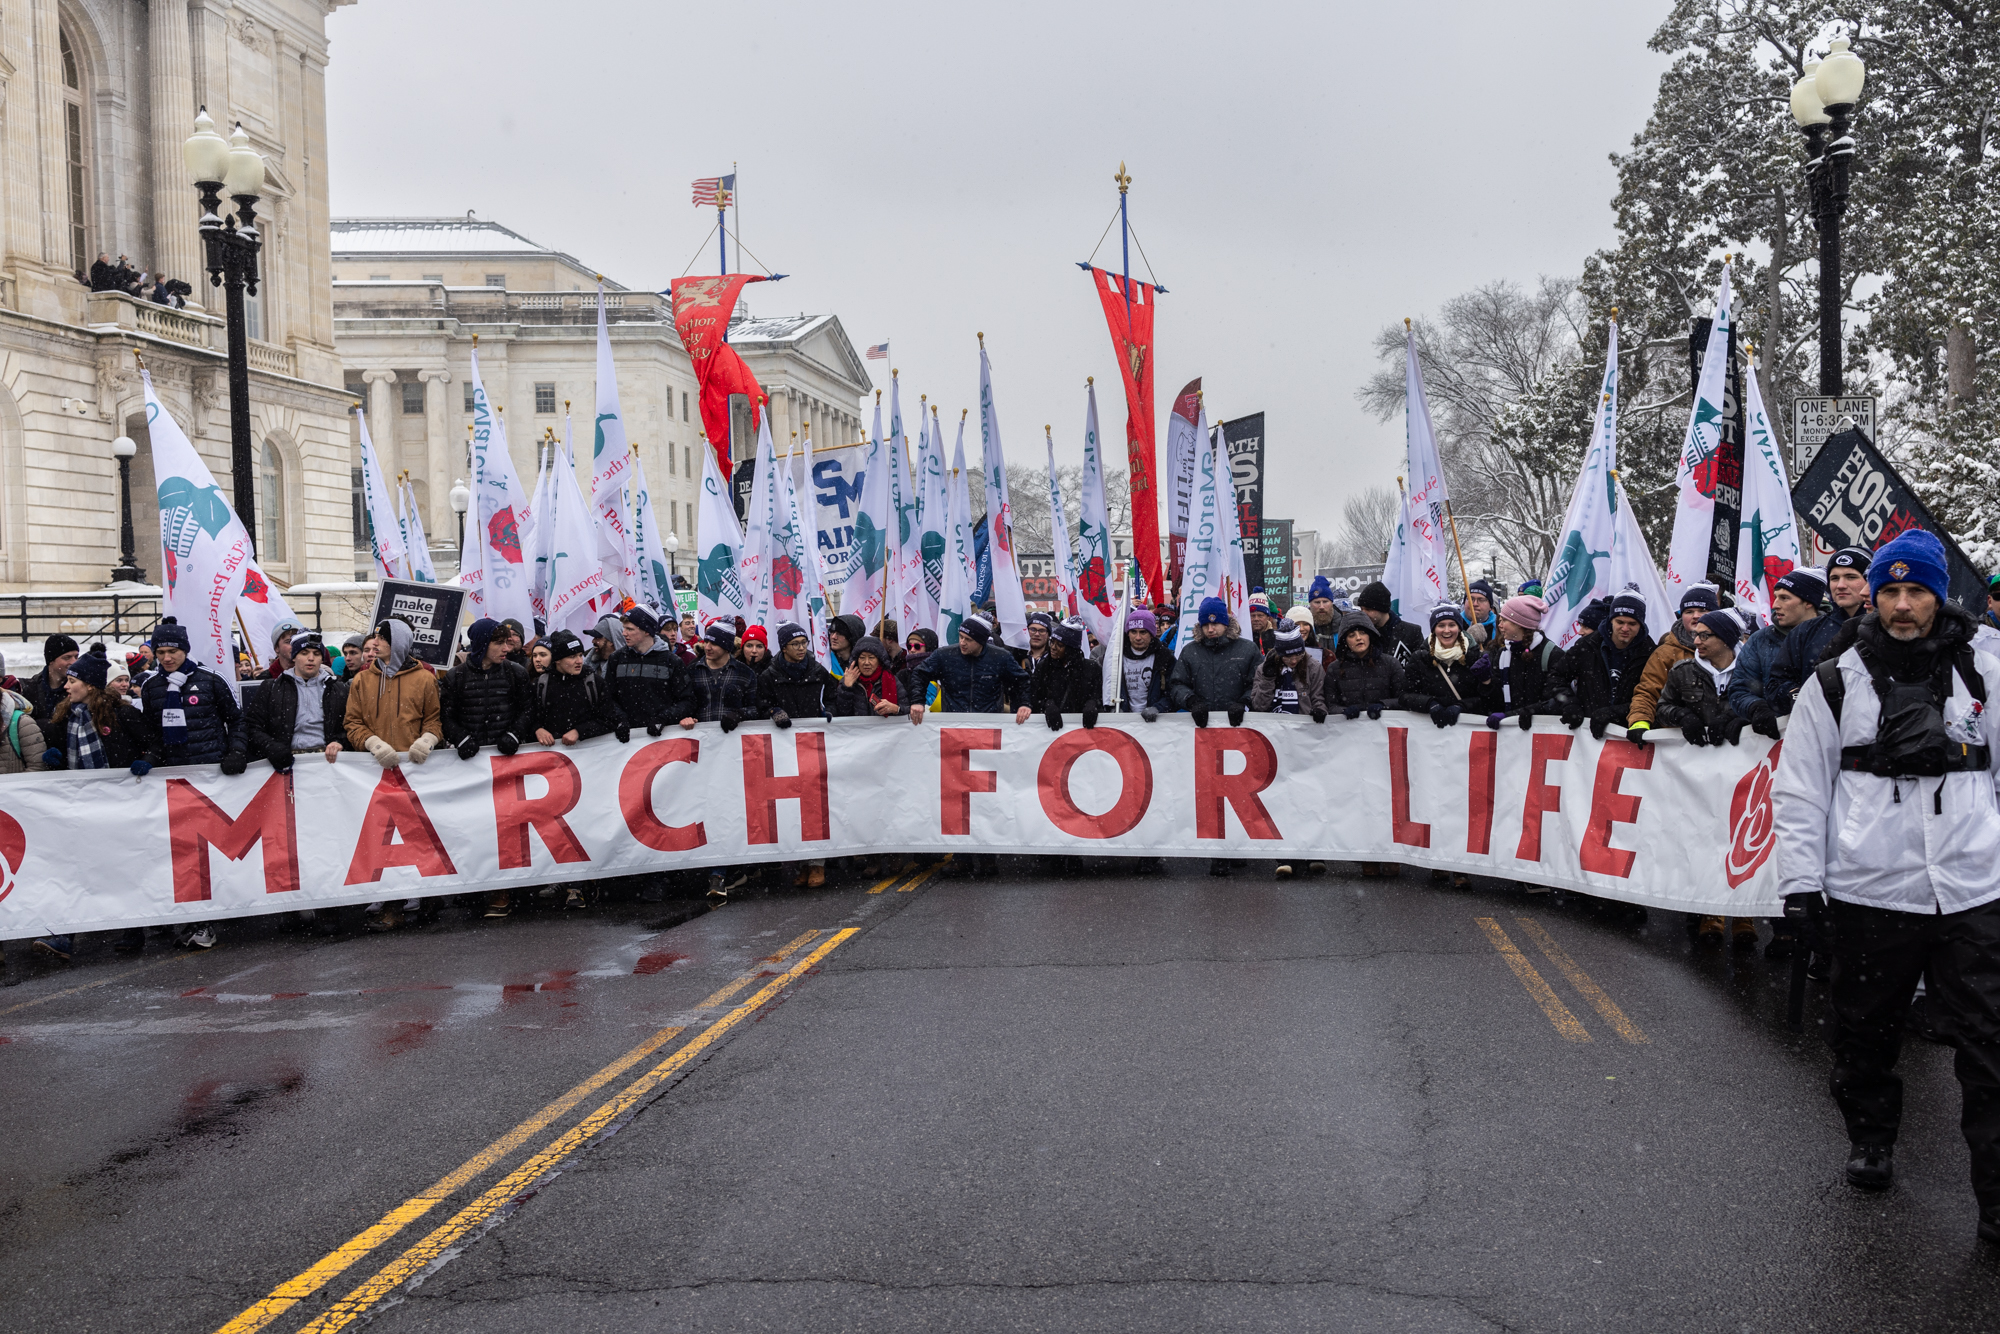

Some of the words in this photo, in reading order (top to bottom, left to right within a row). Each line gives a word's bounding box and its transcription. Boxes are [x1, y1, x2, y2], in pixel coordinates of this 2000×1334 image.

[1801, 401, 1827, 413] ONE
[1836, 400, 1869, 412] LANE
[1852, 414, 1869, 426] PM
[1805, 446, 1812, 458] 2
[1809, 443, 1866, 524] DEATH
[1177, 475, 1190, 529] LIFE
[1715, 487, 1741, 511] ERE!
[1822, 458, 1885, 547] IS
[824, 552, 850, 566] OR
[1263, 556, 1287, 565] RVES
[1713, 552, 1735, 569] WHITE
[1716, 561, 1733, 576] ROSE
[828, 577, 846, 586] BISM
[1736, 578, 1756, 603] the
[394, 598, 433, 612] make
[685, 594, 696, 602] LIFE
[413, 629, 438, 643] ies.
[166, 732, 830, 903] MARCH
[941, 727, 1282, 840] FOR
[1388, 728, 1655, 878] LIFE
